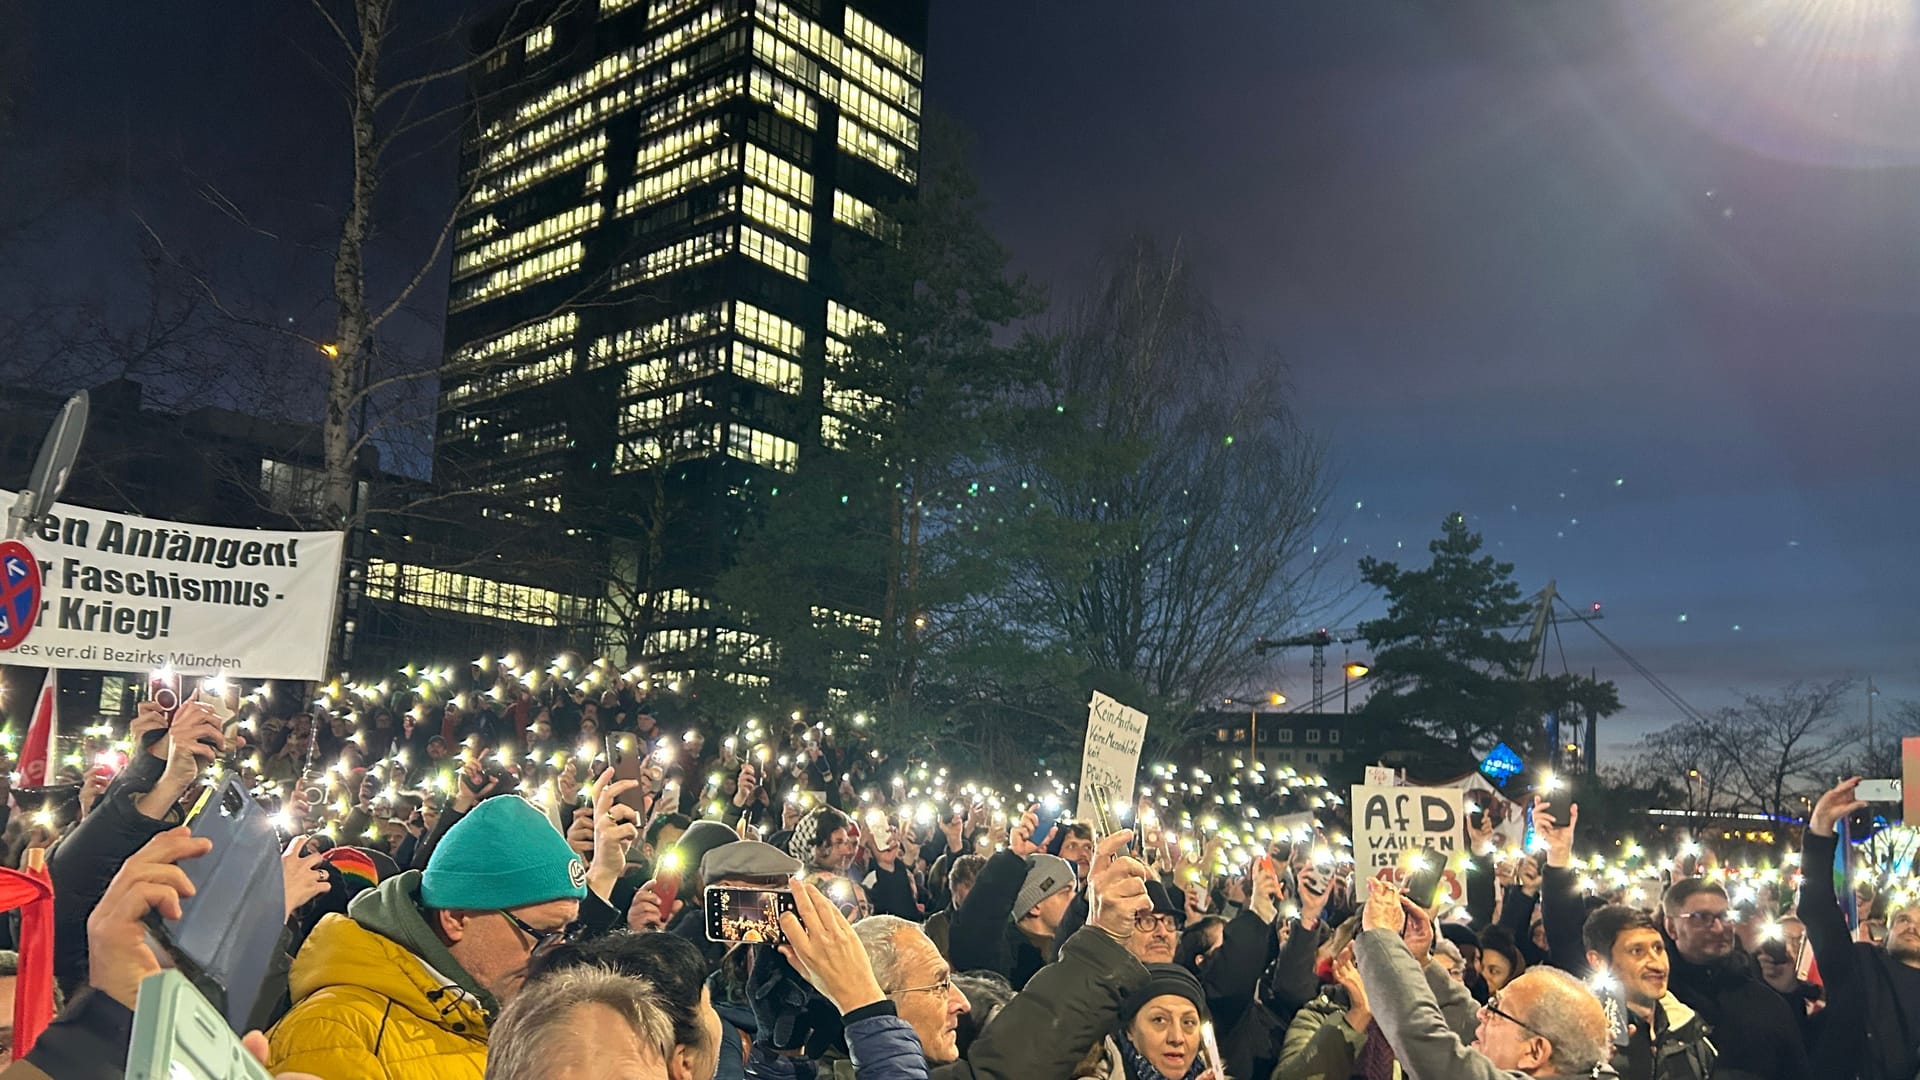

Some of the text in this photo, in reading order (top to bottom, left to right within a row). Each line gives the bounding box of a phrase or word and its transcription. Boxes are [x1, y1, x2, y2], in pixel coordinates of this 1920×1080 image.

[36, 513, 298, 568] en Anfängen!
[58, 596, 171, 640] Krieg!
[45, 646, 97, 661] ver.di
[103, 647, 164, 664] Bezirks
[169, 652, 242, 669] München
[1093, 696, 1114, 724] Kein
[1365, 794, 1455, 832] AfD
[1368, 832, 1454, 851] WÄHLEN
[1372, 853, 1399, 867] IST
[1376, 867, 1462, 900] 193
